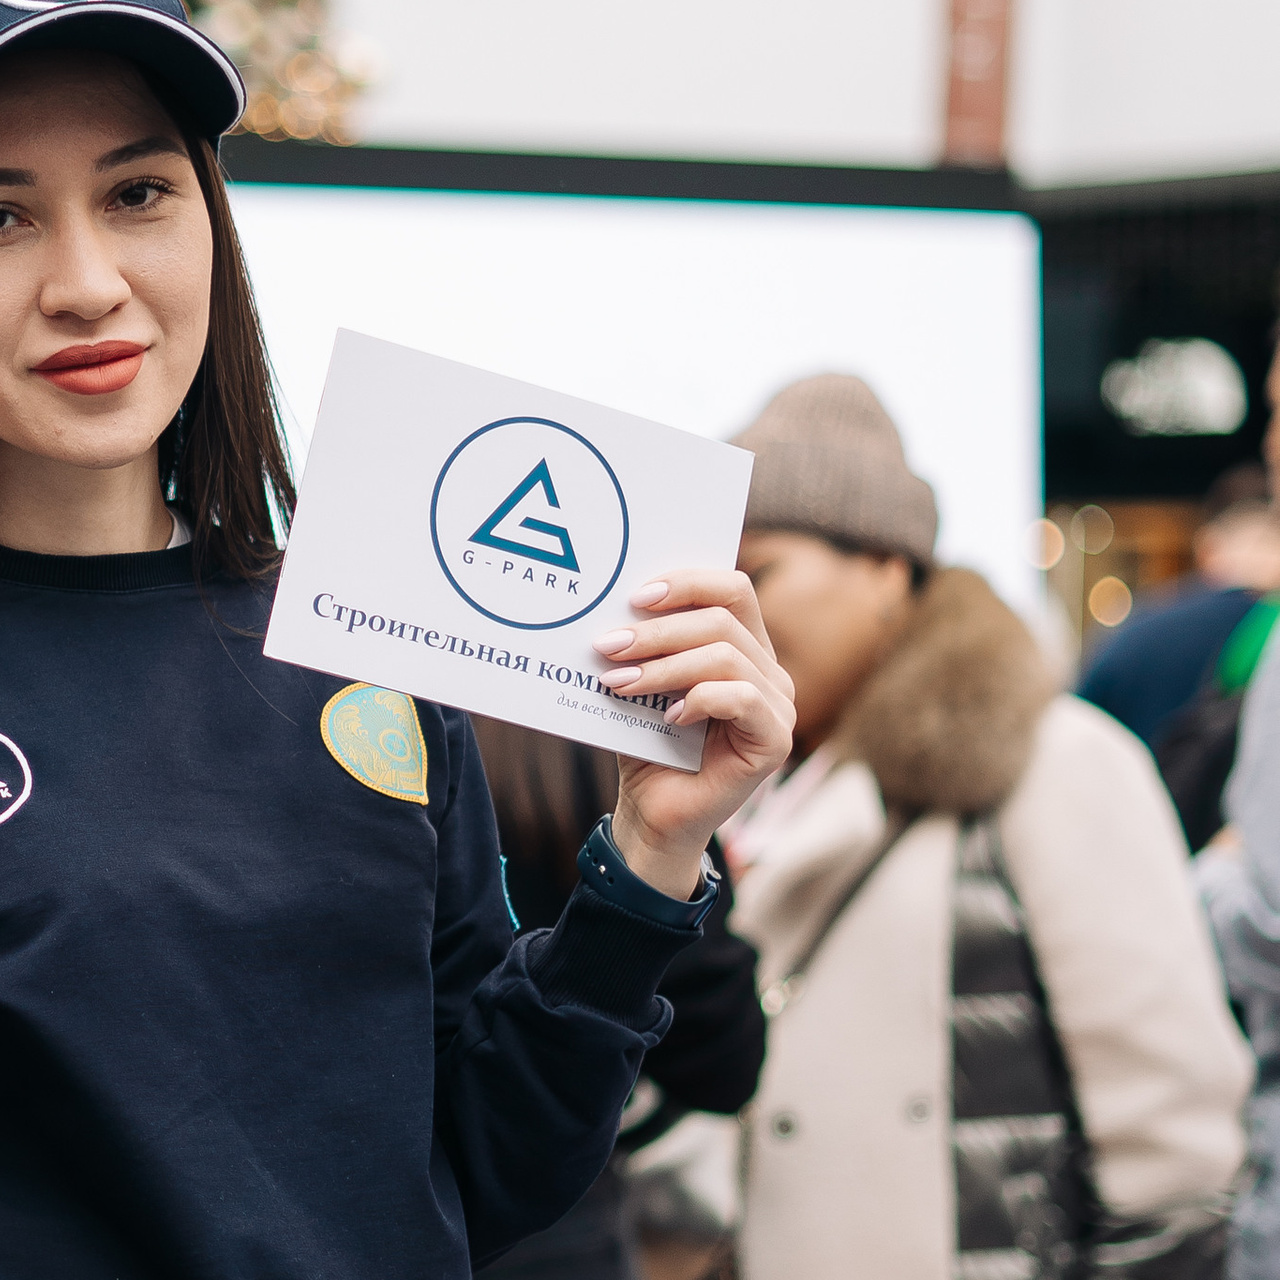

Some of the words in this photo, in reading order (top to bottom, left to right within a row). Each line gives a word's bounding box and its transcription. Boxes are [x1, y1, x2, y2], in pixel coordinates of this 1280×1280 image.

[462, 549, 580, 595] G-PARK
[312, 592, 531, 674] Строительная
[556, 690, 578, 709] для
[581, 704, 609, 721] всех
